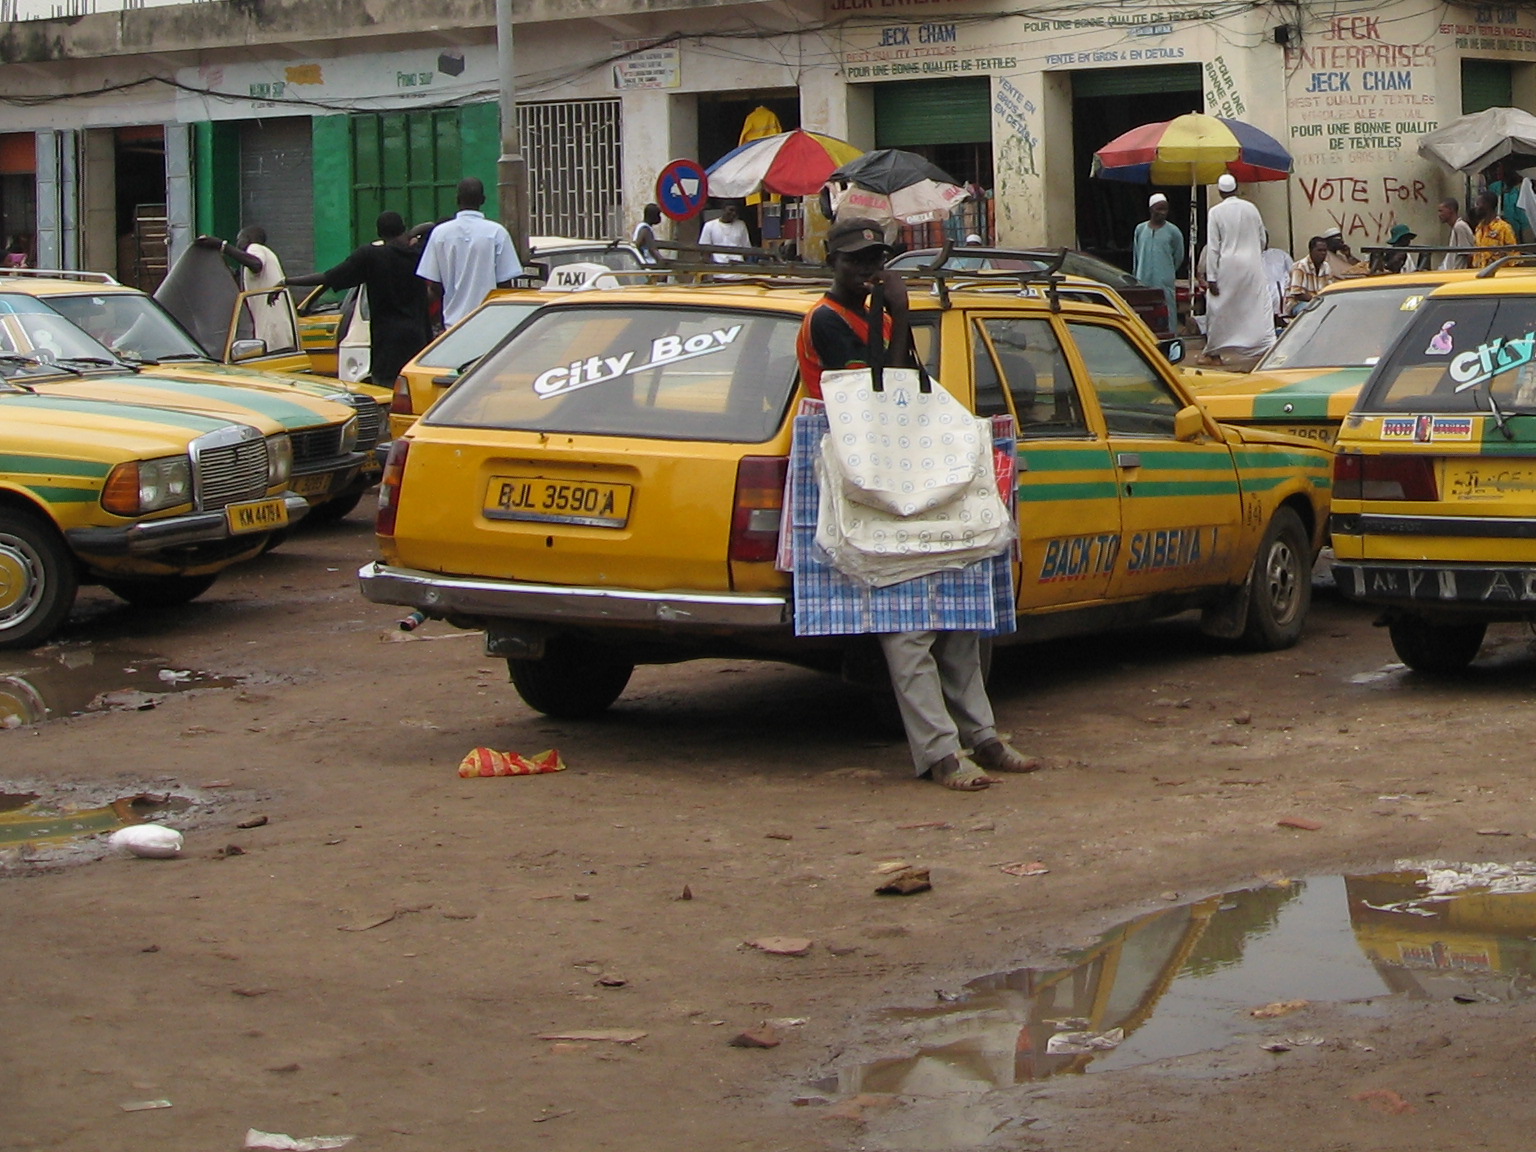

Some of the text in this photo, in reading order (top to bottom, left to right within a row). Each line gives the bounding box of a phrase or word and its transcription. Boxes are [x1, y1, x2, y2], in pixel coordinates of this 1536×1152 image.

[878, 23, 957, 47] JECK CHAM
[1024, 21, 1050, 32] POUR
[1321, 16, 1381, 41] JECK
[848, 57, 1017, 78] POUR UNE BONNE QUALITE DE TEXTILES
[1045, 53, 1076, 65] VENTE
[1078, 51, 1091, 62] EN
[1093, 50, 1118, 62] GROS
[1129, 50, 1143, 60] EN
[1146, 47, 1185, 60] DETAILS
[1284, 45, 1437, 70] ENTERPRISES
[998, 76, 1024, 104] VENTE
[1205, 62, 1227, 101] BONNE
[1214, 55, 1246, 115] POUR UNE
[1305, 70, 1412, 93] JECK CHAM
[996, 91, 1019, 114] GROS
[1206, 91, 1218, 109] DE
[1291, 121, 1438, 138] POUR UNE BONNE QUALITE
[1329, 136, 1402, 151] DE TEXTILES
[1299, 177, 1428, 208] VOTE FOR
[557, 271, 586, 286] TAXI
[1450, 331, 1536, 383] City
[533, 350, 636, 396] City
[498, 483, 535, 509] BJL
[542, 484, 598, 512] 3590
[1039, 536, 1093, 581] BACK
[1094, 533, 1121, 576] TO
